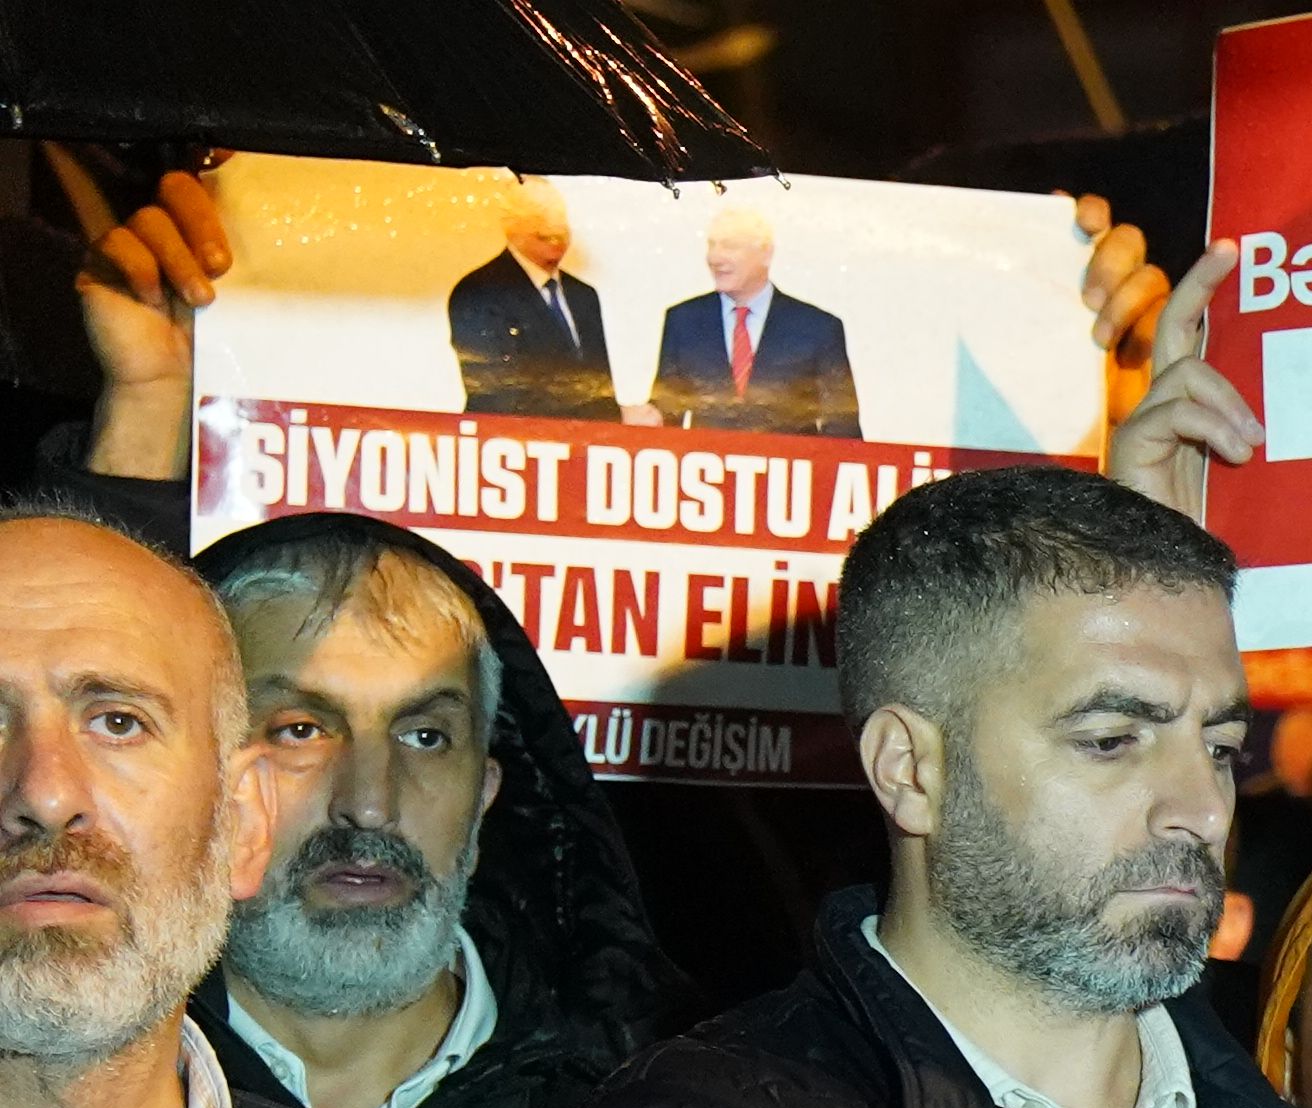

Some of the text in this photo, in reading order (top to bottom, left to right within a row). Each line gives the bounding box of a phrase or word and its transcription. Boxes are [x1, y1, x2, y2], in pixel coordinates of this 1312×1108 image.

[246, 409, 570, 522] SİYONİST
[586, 444, 812, 538] DOSTU
[463, 559, 660, 658] 'TAN
[640, 713, 793, 775] DEĞİŞİM
